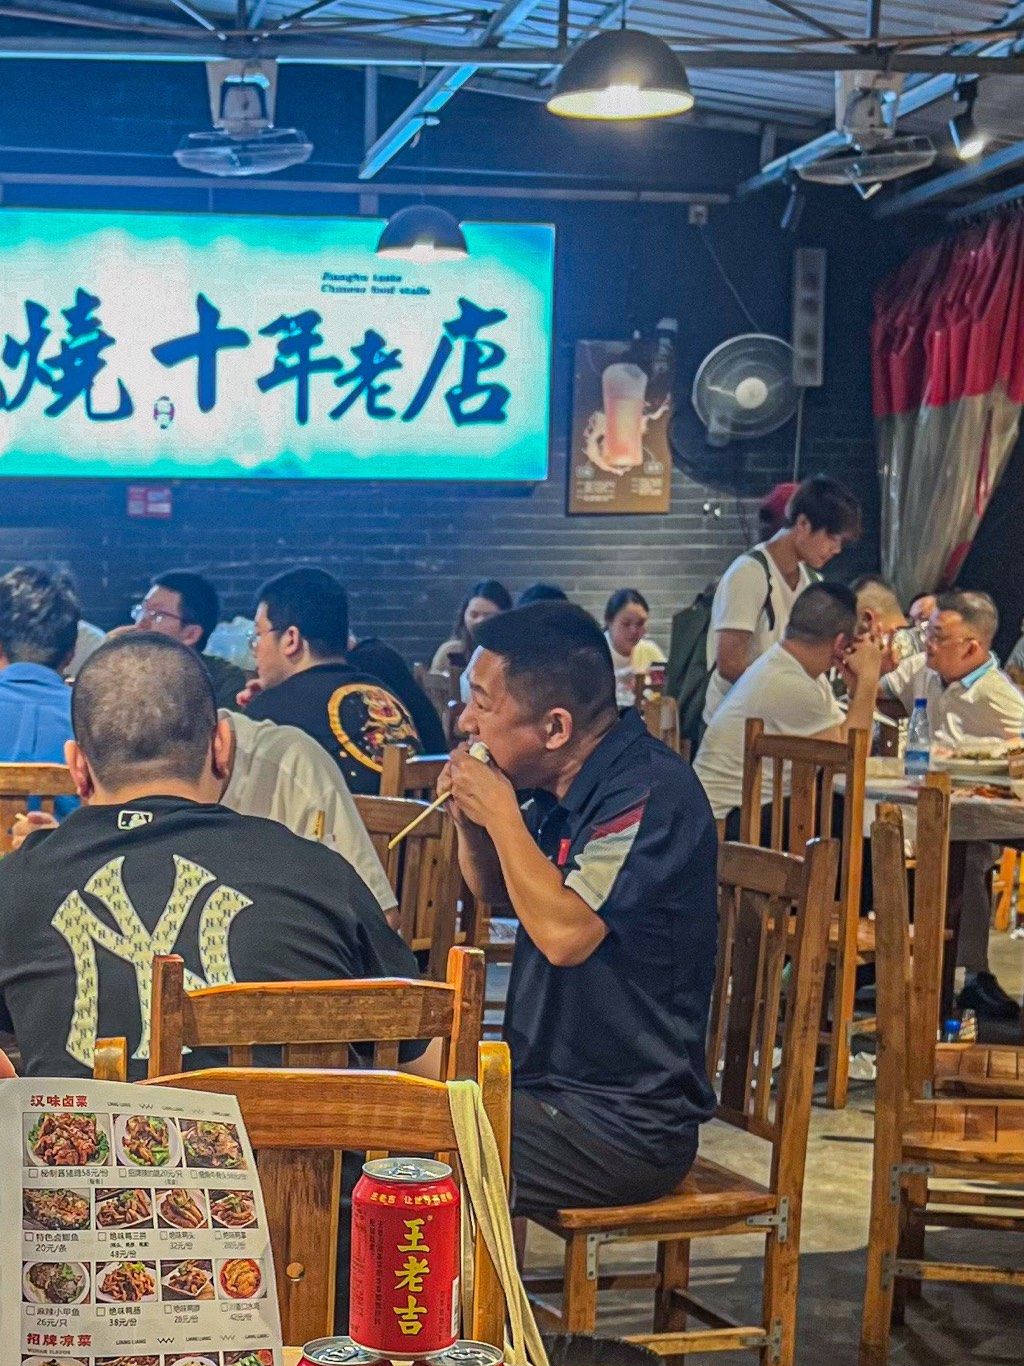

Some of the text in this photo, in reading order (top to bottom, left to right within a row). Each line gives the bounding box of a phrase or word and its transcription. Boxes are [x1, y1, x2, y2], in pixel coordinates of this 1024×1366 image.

[150, 293, 511, 428] 十年老店
[30, 1095, 88, 1108] 汉味卤菜
[393, 1217, 432, 1336] 王老吉
[37, 1319, 68, 1327] 26元/只
[27, 1333, 92, 1347] 招牌凉菜
